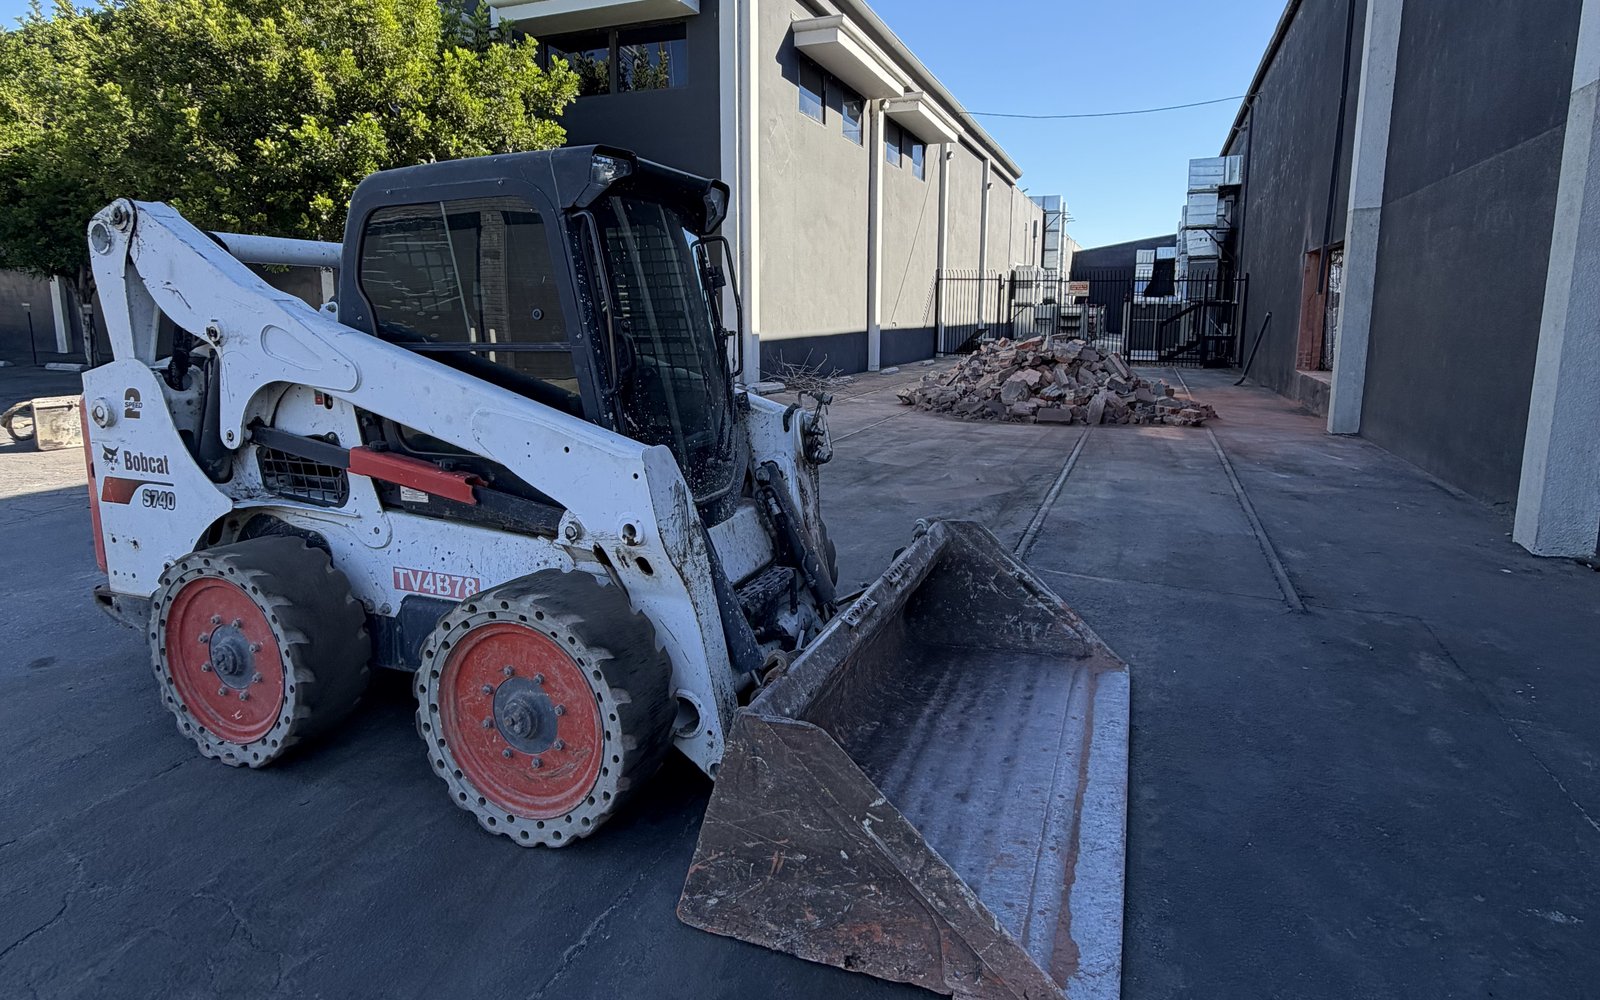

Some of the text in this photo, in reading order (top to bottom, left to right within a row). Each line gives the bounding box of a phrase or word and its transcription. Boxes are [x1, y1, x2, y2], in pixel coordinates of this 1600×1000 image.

[124, 387, 141, 419] 2
[124, 401, 143, 409] SPEED
[123, 450, 170, 475] Bobcat
[142, 488, 176, 511] S740
[394, 567, 477, 598] TV4B78
